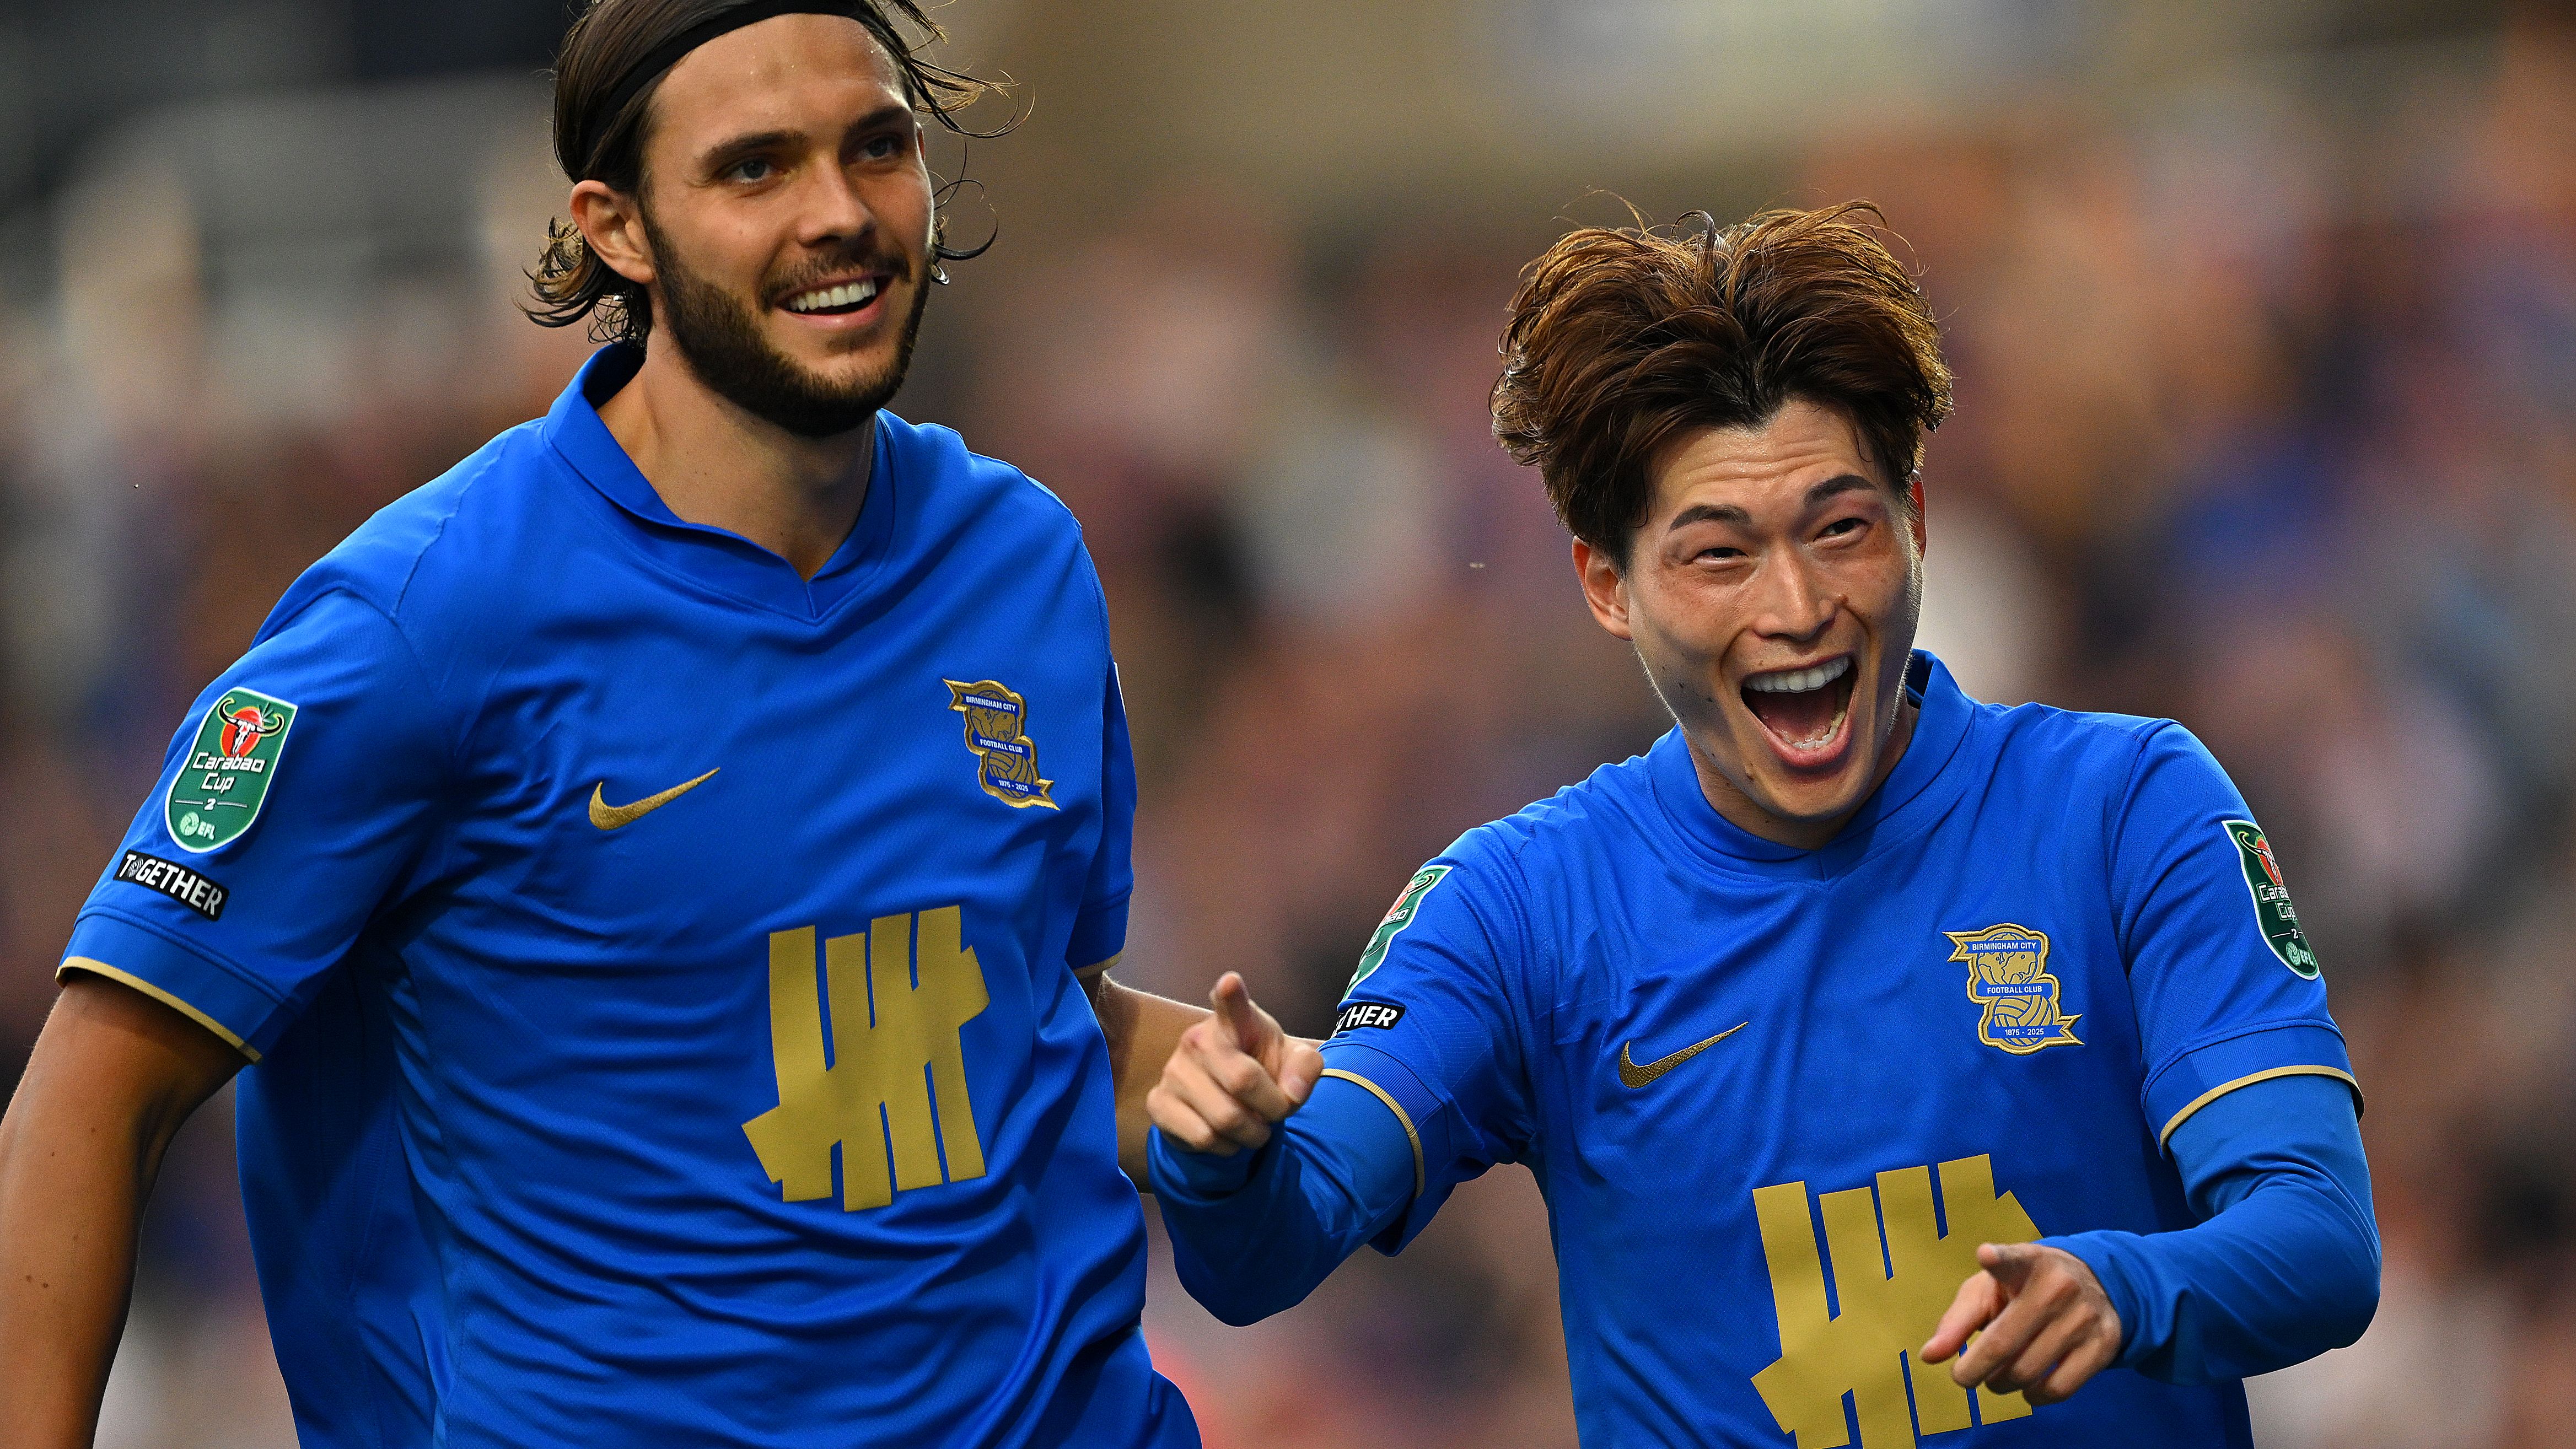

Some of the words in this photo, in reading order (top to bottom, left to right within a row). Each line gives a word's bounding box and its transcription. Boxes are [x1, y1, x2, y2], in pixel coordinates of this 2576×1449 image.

[966, 696, 1002, 709] BIRMINGHAM
[1003, 703, 1016, 712] CITY
[980, 739, 1008, 751] FOOTBALL
[1008, 744, 1023, 753] CLUB
[192, 752, 266, 773] Carabao
[201, 773, 235, 794] Cup
[203, 798, 216, 811] 2
[198, 821, 215, 841] EFL
[119, 853, 223, 916] TOGETHER
[2290, 928, 2299, 939] 2
[1972, 942, 2019, 951] BIRMINGHAM
[2299, 948, 2315, 967] EFL
[1987, 986, 2023, 994] FOOTBALL
[2004, 1028, 2020, 1036] 1875
